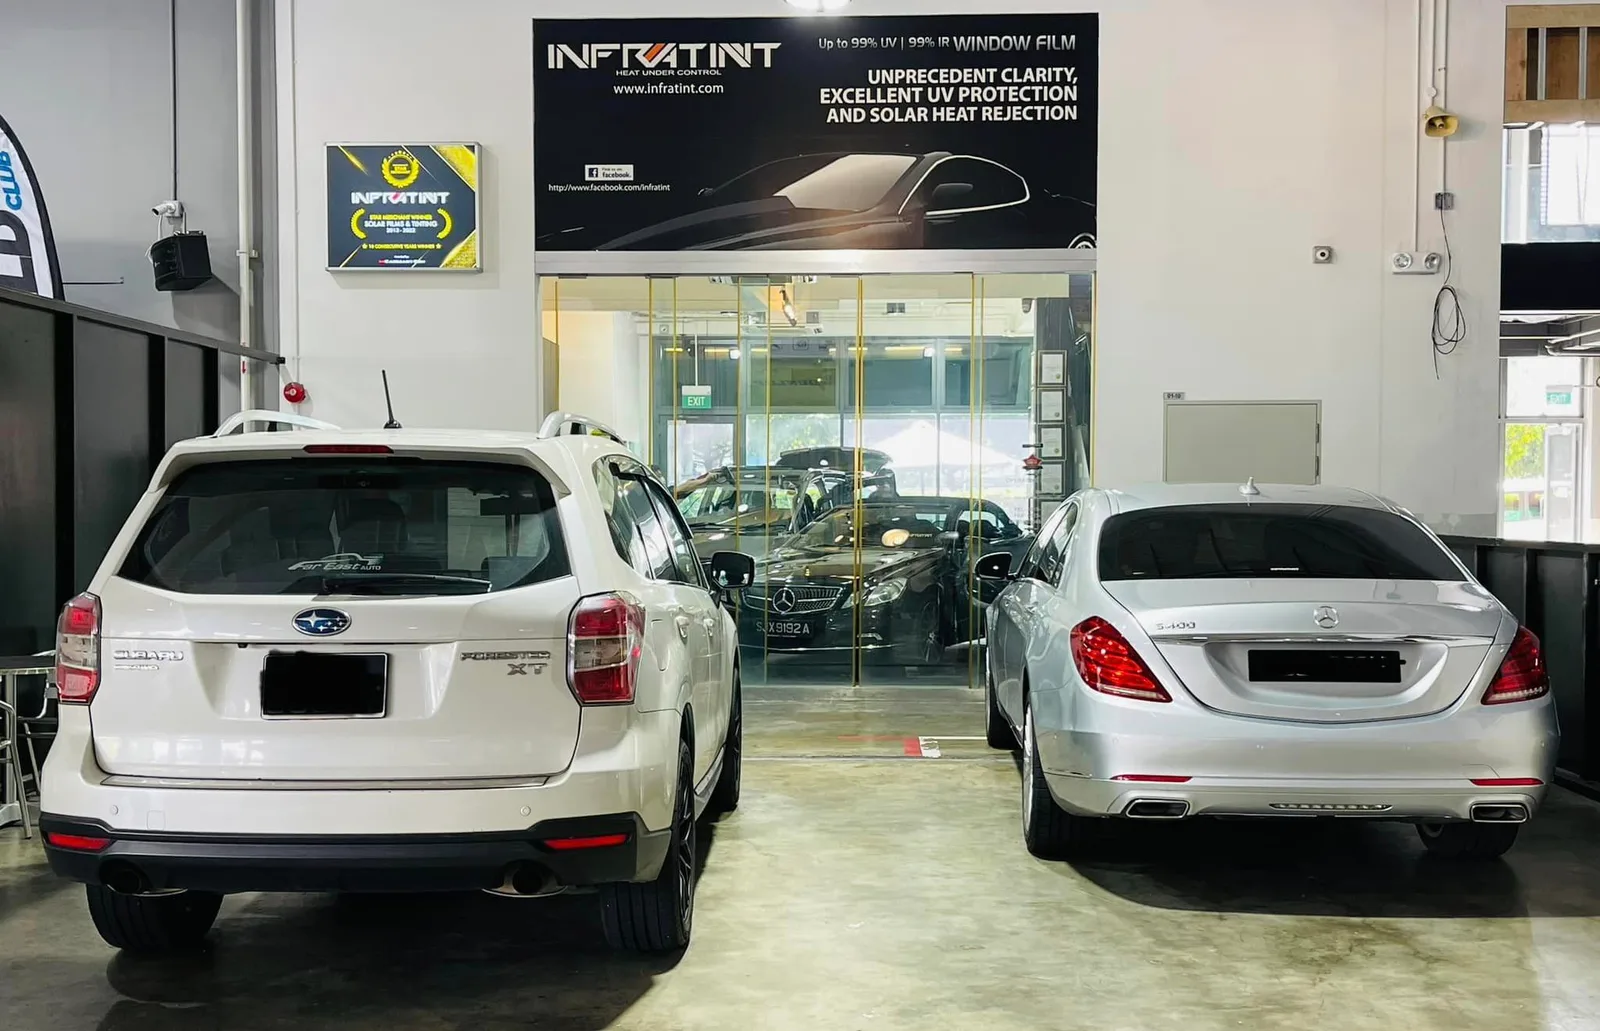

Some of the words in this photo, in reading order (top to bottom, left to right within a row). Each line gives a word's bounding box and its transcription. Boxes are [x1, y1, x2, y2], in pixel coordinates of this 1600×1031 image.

[819, 38, 834, 51] Up
[837, 38, 848, 49] to
[851, 38, 878, 49] 99%
[880, 37, 898, 48] UV
[908, 37, 936, 48] 99%
[938, 37, 950, 48] IR
[953, 36, 1031, 51] WINDOW
[1036, 35, 1076, 50] FILM
[547, 43, 782, 69] INFRATINT
[868, 68, 997, 84] UNPRECEDENT
[1001, 67, 1078, 84] CLARITY,
[613, 82, 724, 95] www.infratint.com
[820, 87, 923, 104] EXCELLENT
[927, 87, 954, 102] UV
[958, 86, 1078, 102] PROTECTION
[826, 107, 866, 123] AND
[870, 106, 929, 122] SOLAR
[932, 106, 978, 122] HEAT
[982, 105, 1078, 121] REJECTION
[548, 182, 670, 193] http://www.facebook.com/infratint
[364, 220, 386, 228] SOLAR
[411, 220, 438, 228] TINTING
[687, 396, 706, 407] EXIT
[323, 561, 361, 571] East
[756, 620, 810, 634] SX9192A
[114, 650, 184, 661] SUBARU
[461, 651, 551, 661] FORESTER
[507, 662, 548, 676] XT
